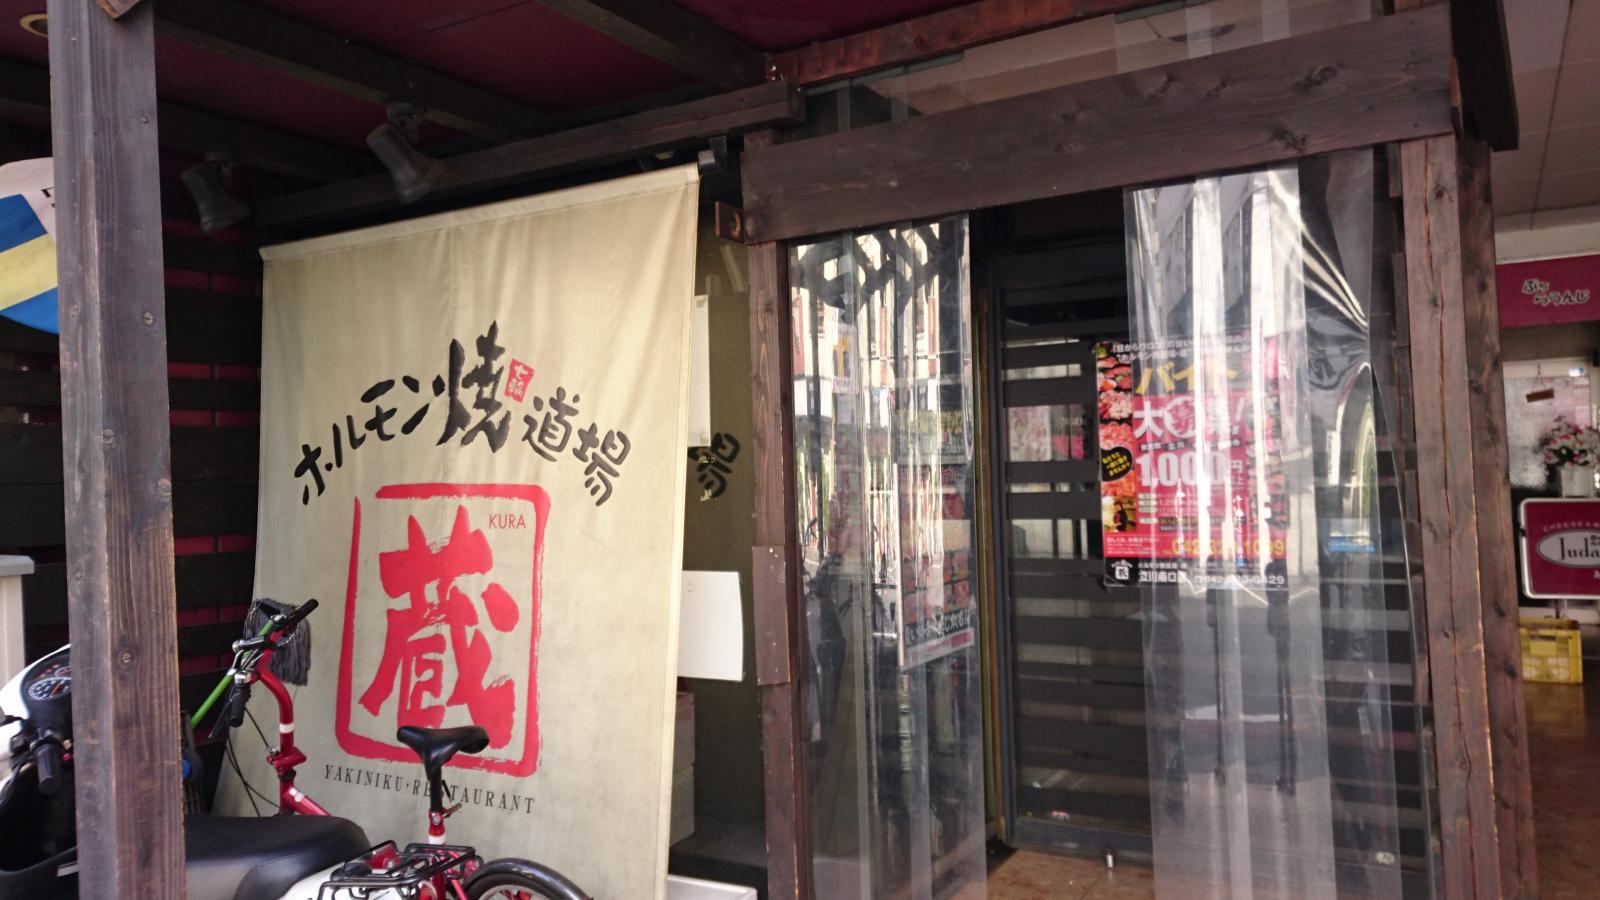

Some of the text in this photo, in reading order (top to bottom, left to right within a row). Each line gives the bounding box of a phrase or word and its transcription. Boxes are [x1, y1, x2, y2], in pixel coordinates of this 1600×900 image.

[293, 320, 632, 506] ホルモン焼道場
[488, 513, 527, 530] KURA
[357, 503, 520, 750] 蔵
